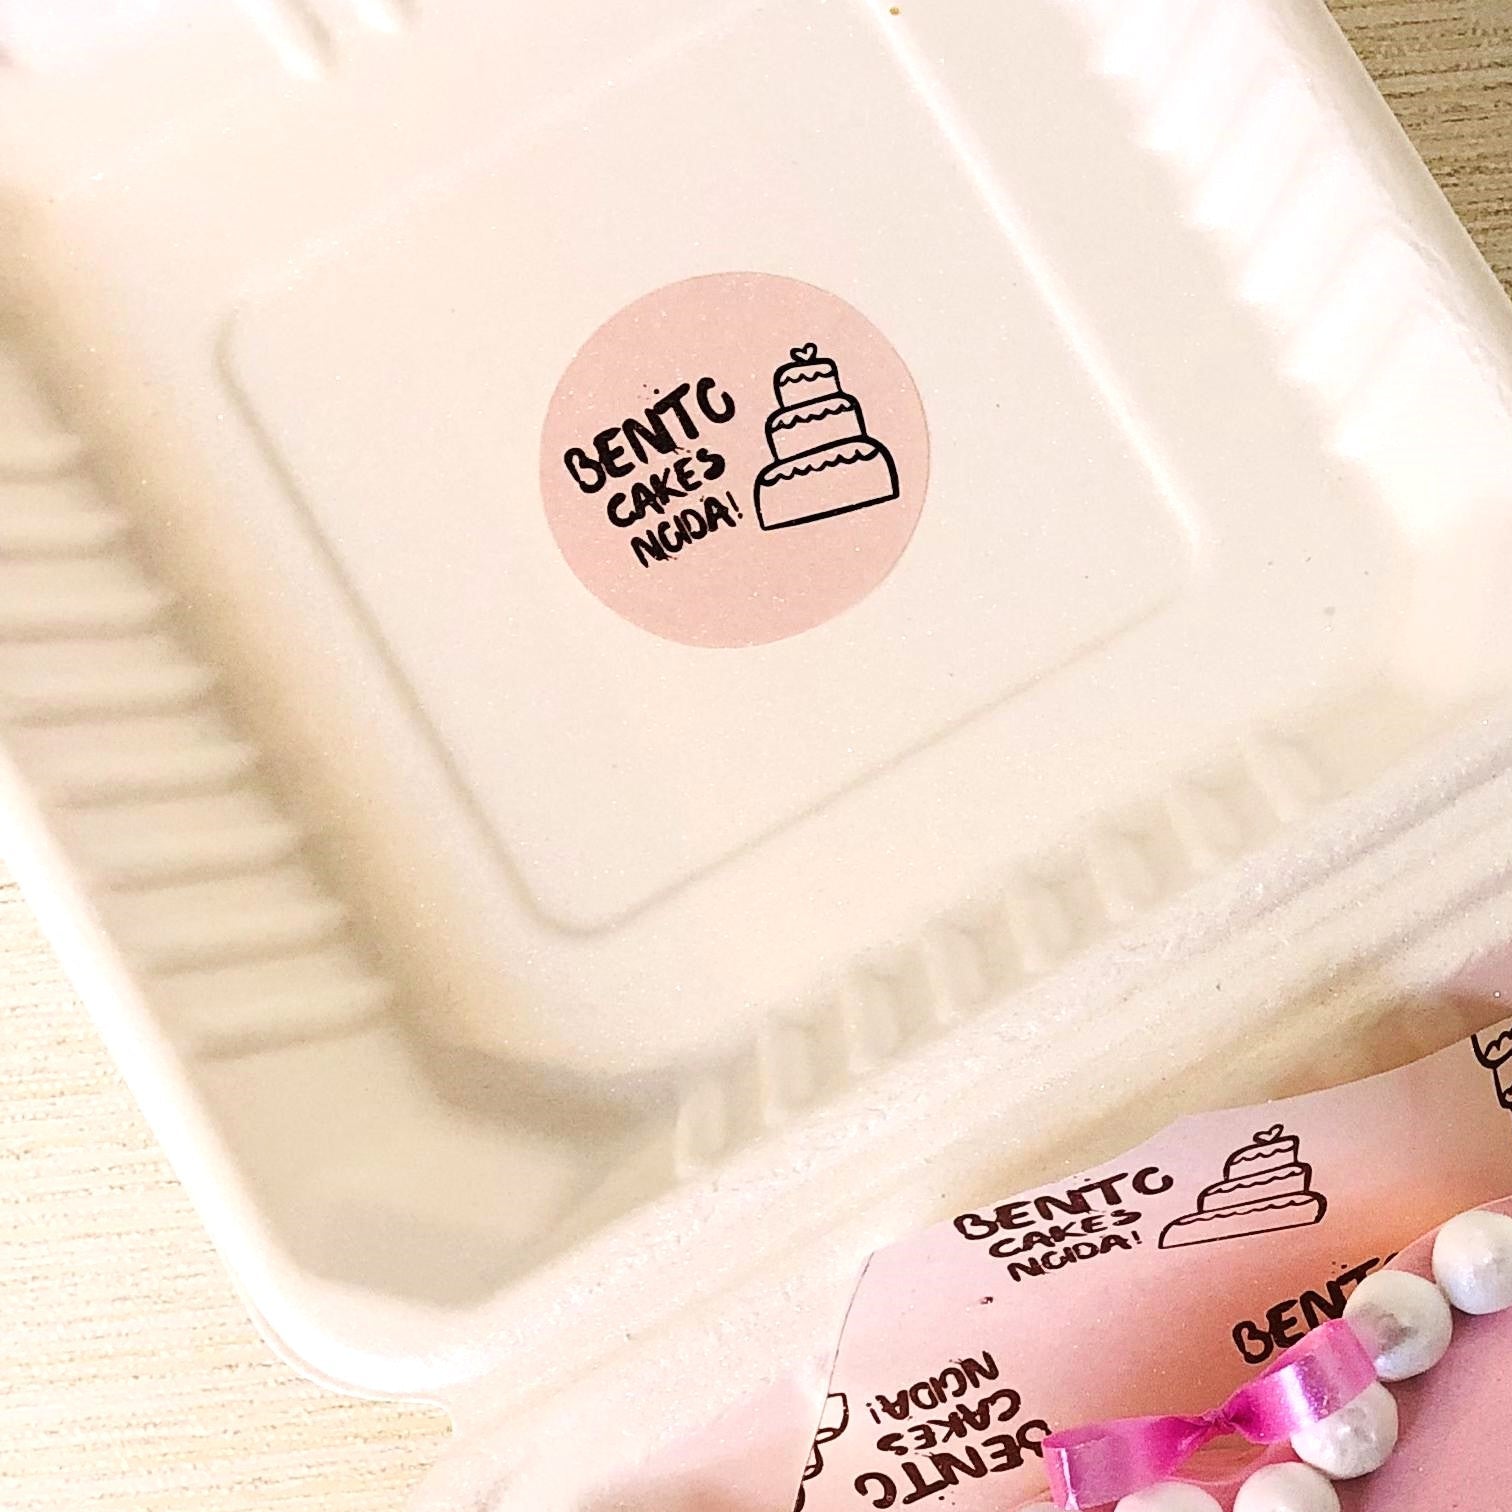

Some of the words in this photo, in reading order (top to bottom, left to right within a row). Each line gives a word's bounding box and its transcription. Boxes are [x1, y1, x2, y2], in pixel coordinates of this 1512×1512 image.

[606, 447, 727, 528] CAKES
[987, 1208, 1143, 1258] CAKES
[1231, 1250, 1400, 1365] BENT
[876, 1387, 1022, 1457] CAKES
